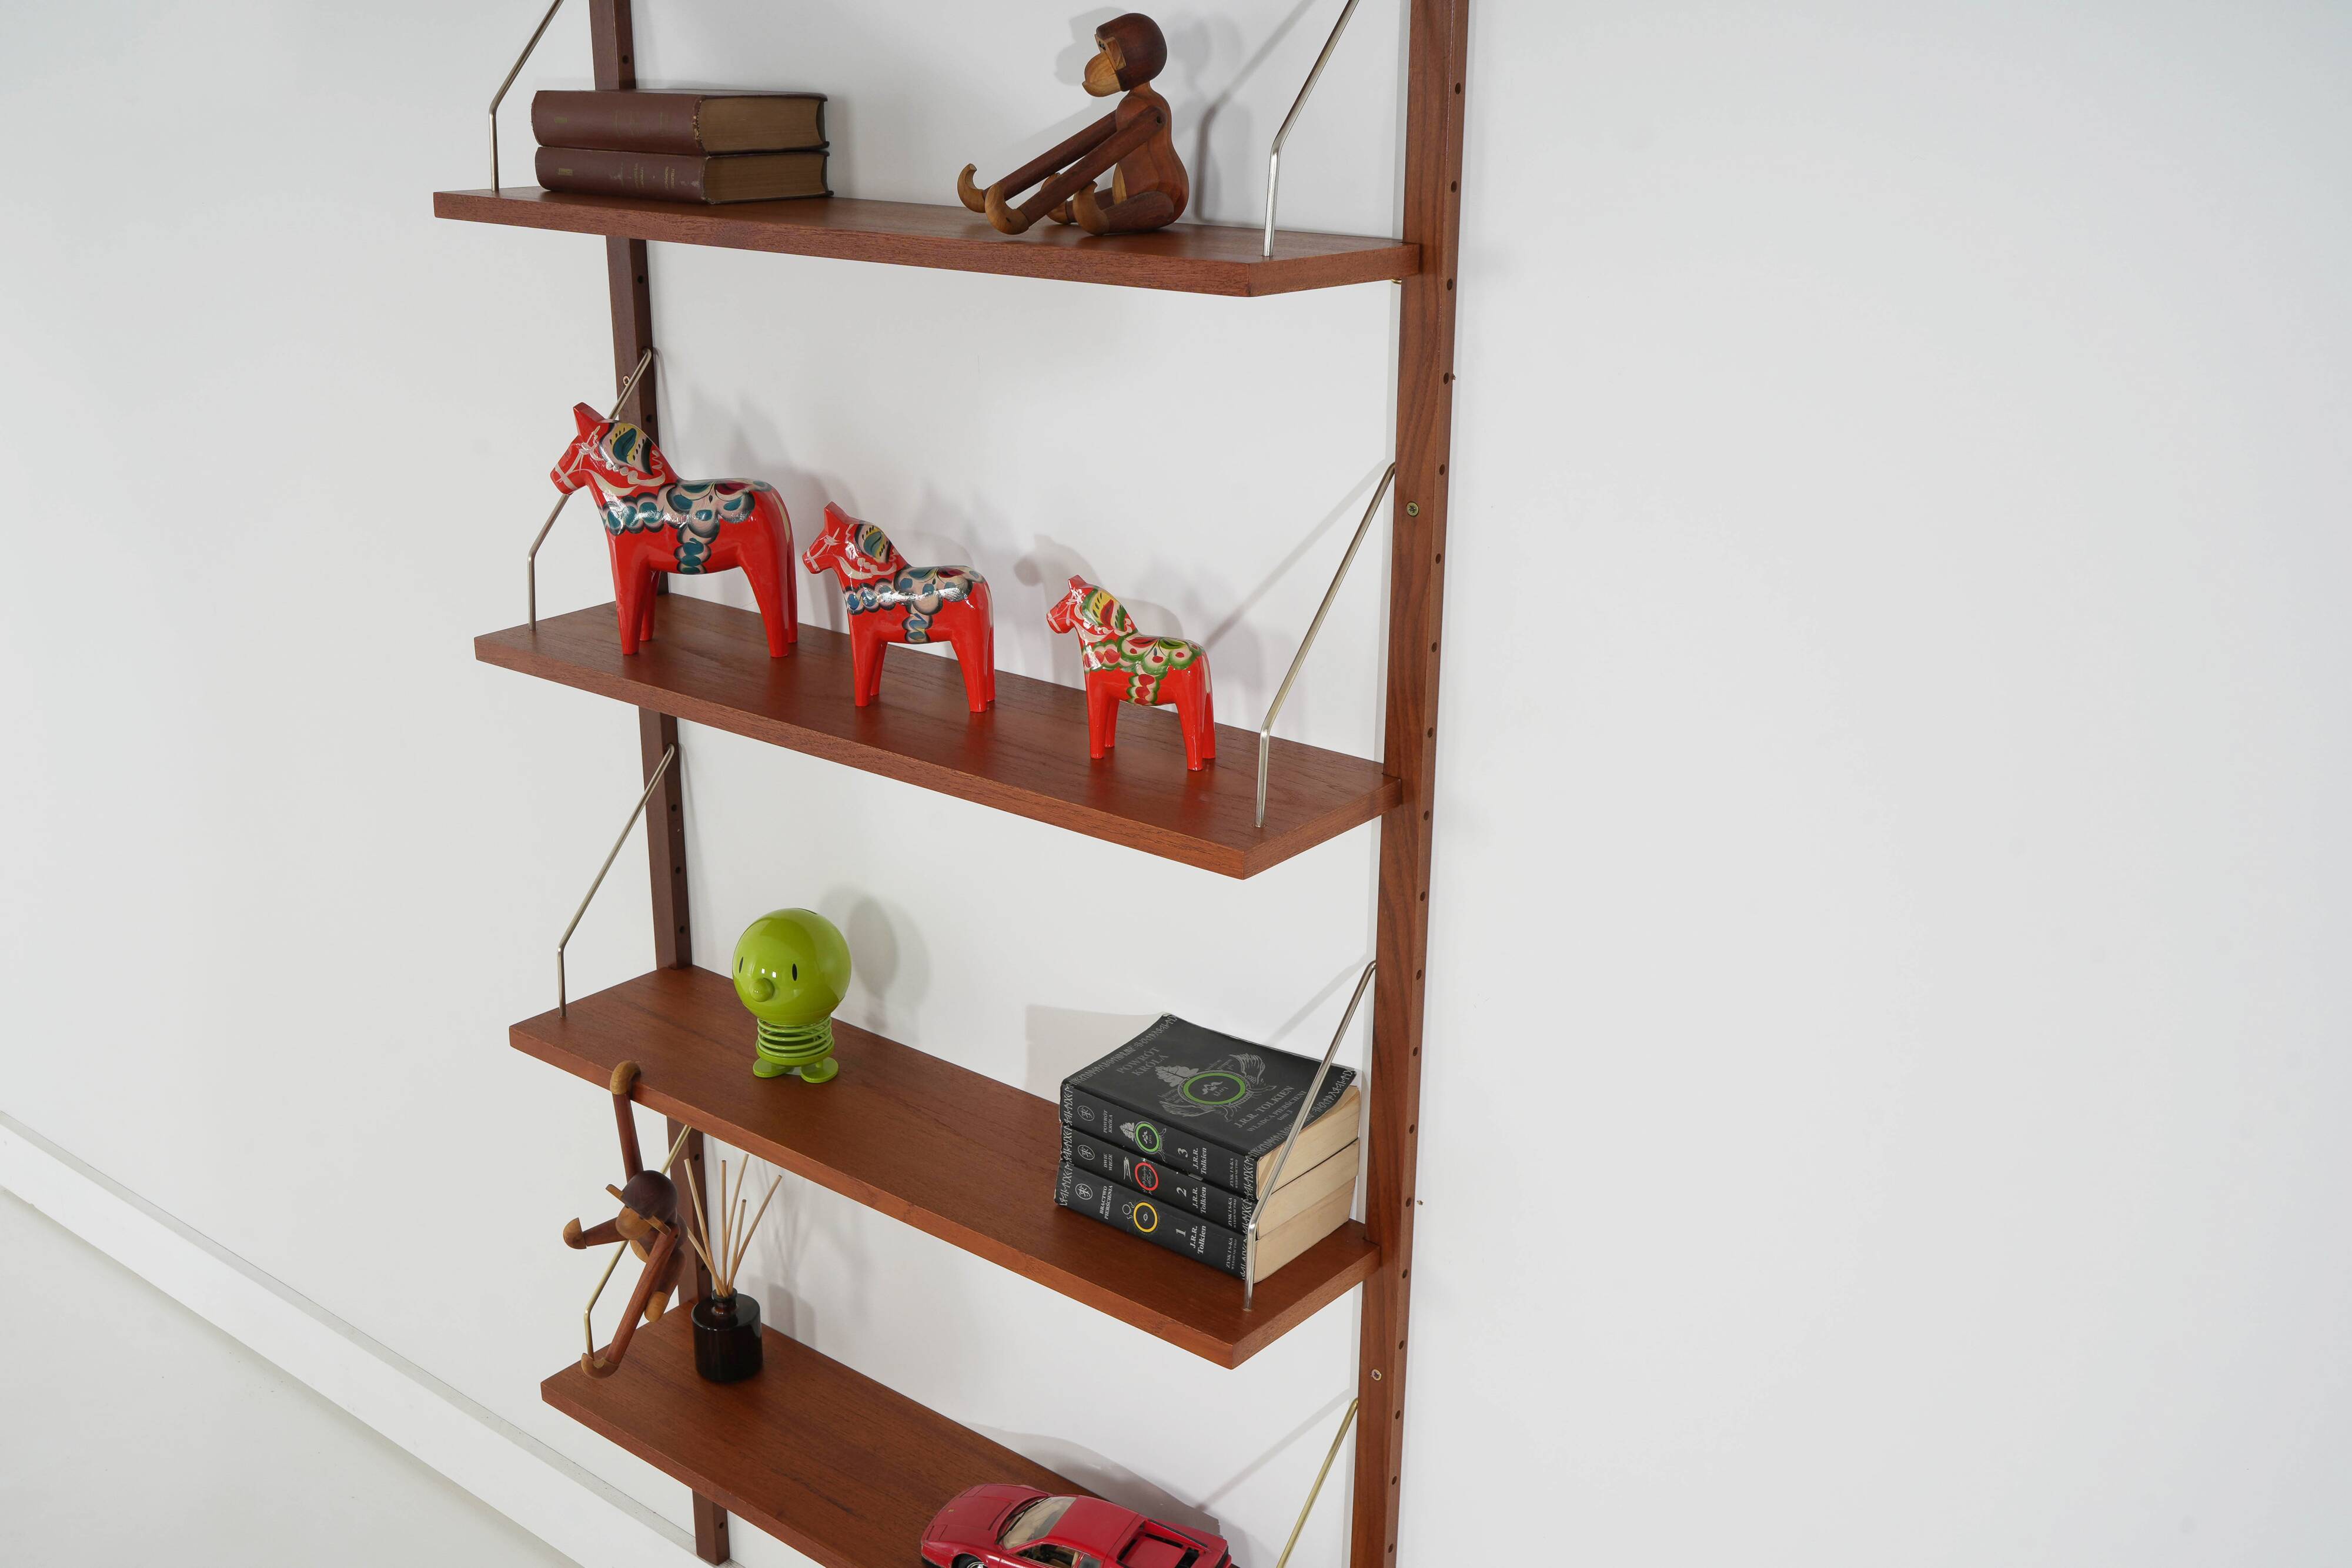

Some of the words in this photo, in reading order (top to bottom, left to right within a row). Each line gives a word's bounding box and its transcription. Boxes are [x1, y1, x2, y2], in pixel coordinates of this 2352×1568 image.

[1117, 1047, 1160, 1074] POWRÓT
[1131, 1054, 1169, 1076] KRÓLA
[1235, 1113, 1259, 1128] J.R.R.
[1255, 1085, 1294, 1112] TOLKIEN
[1177, 1148, 1188, 1158] 3
[1099, 1185, 1108, 1214] BRACTWO
[1104, 1185, 1113, 1220] PIERŚCIENIA
[1176, 1187, 1187, 1197] 2
[1175, 1228, 1186, 1237] 1
[1190, 1226, 1198, 1248] J.R.R.
[1197, 1225, 1207, 1254] Tolkien
